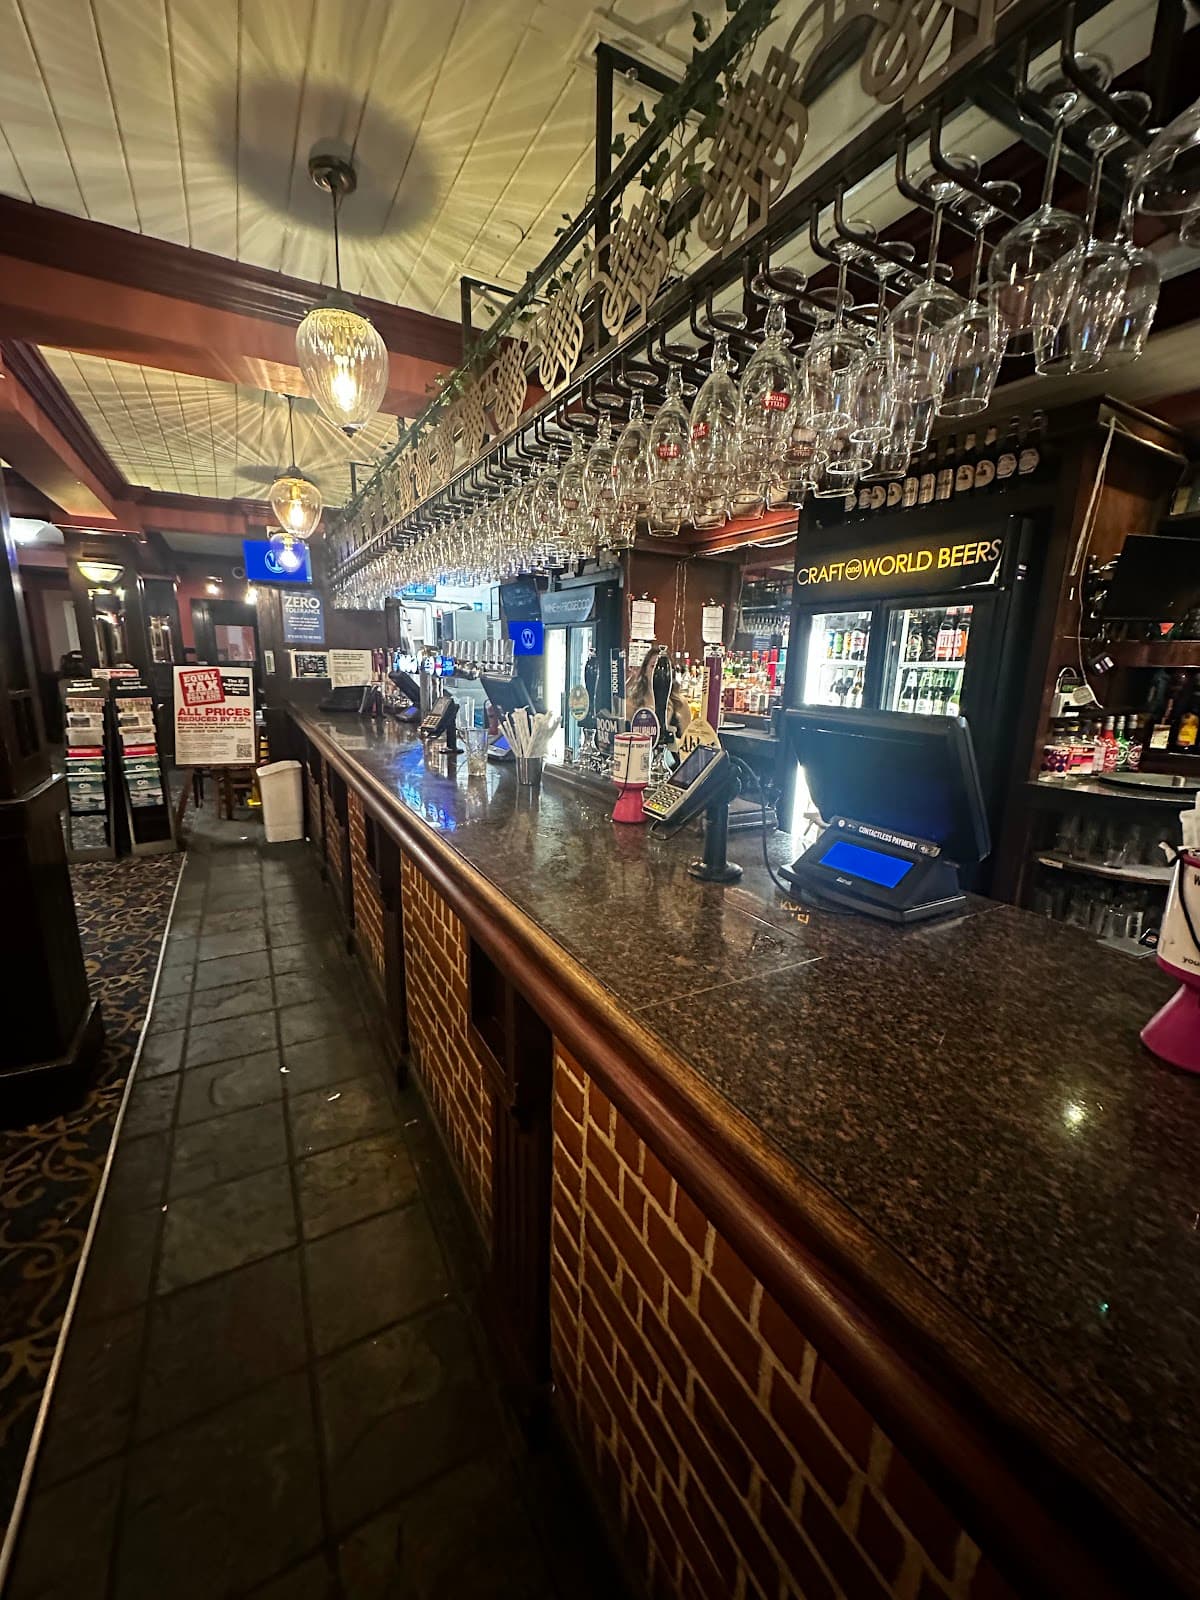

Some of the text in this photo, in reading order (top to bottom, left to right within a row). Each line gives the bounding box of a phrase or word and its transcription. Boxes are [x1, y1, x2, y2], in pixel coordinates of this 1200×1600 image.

[796, 539, 1002, 586] CRAFT and WORLD BEERS
[284, 595, 321, 609] ZERO
[285, 607, 321, 615] TOLERANCE
[184, 671, 218, 683] EQUAL
[184, 680, 220, 693] TAX
[178, 707, 251, 716] ALL PRICES
[858, 826, 918, 851] CONTACTLESS PAYMENT
